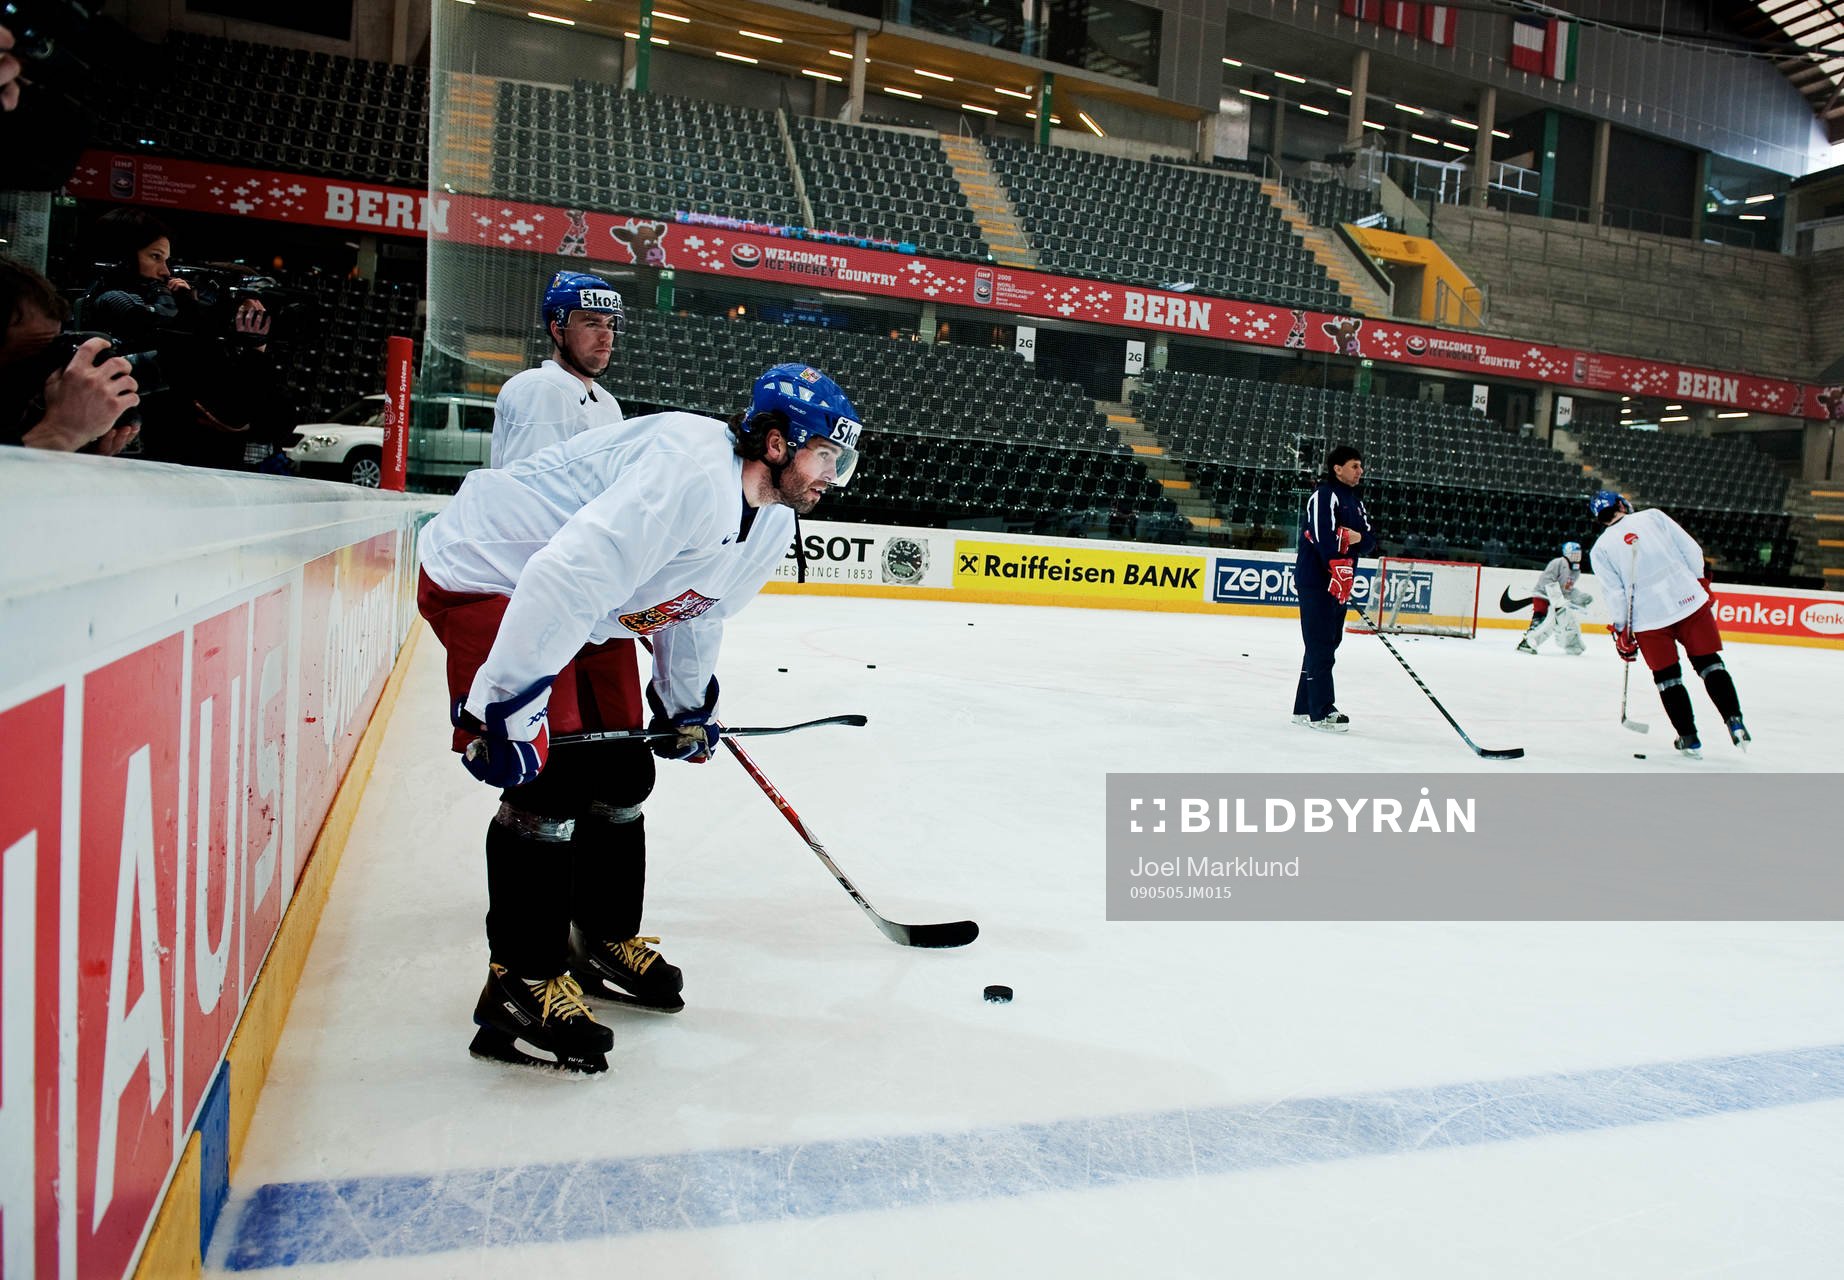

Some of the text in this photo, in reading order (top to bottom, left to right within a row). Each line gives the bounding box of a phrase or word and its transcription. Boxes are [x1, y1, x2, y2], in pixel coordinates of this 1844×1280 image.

[324, 185, 450, 233] BERN
[765, 247, 847, 268] WELCOME TO
[764, 259, 897, 286] ICE HOCKEY COUNTRY
[1123, 291, 1212, 331] BERN
[1018, 338, 1033, 349] 2G
[1429, 338, 1487, 355] WELCOME TO
[1128, 352, 1142, 362] 2G
[1479, 355, 1521, 369] COUNTRY
[1677, 371, 1739, 404] BERN
[1475, 395, 1486, 405] 2G
[395, 360, 408, 472] Professional Ice Rink Systems
[1559, 406, 1570, 416] 2H
[833, 419, 858, 448] Ško
[804, 566, 839, 578] SINCE
[847, 568, 873, 580] 1853
[984, 555, 1201, 589] Raiffeisen BANK
[1350, 573, 1429, 606] epter
[1805, 611, 1844, 625] Henk
